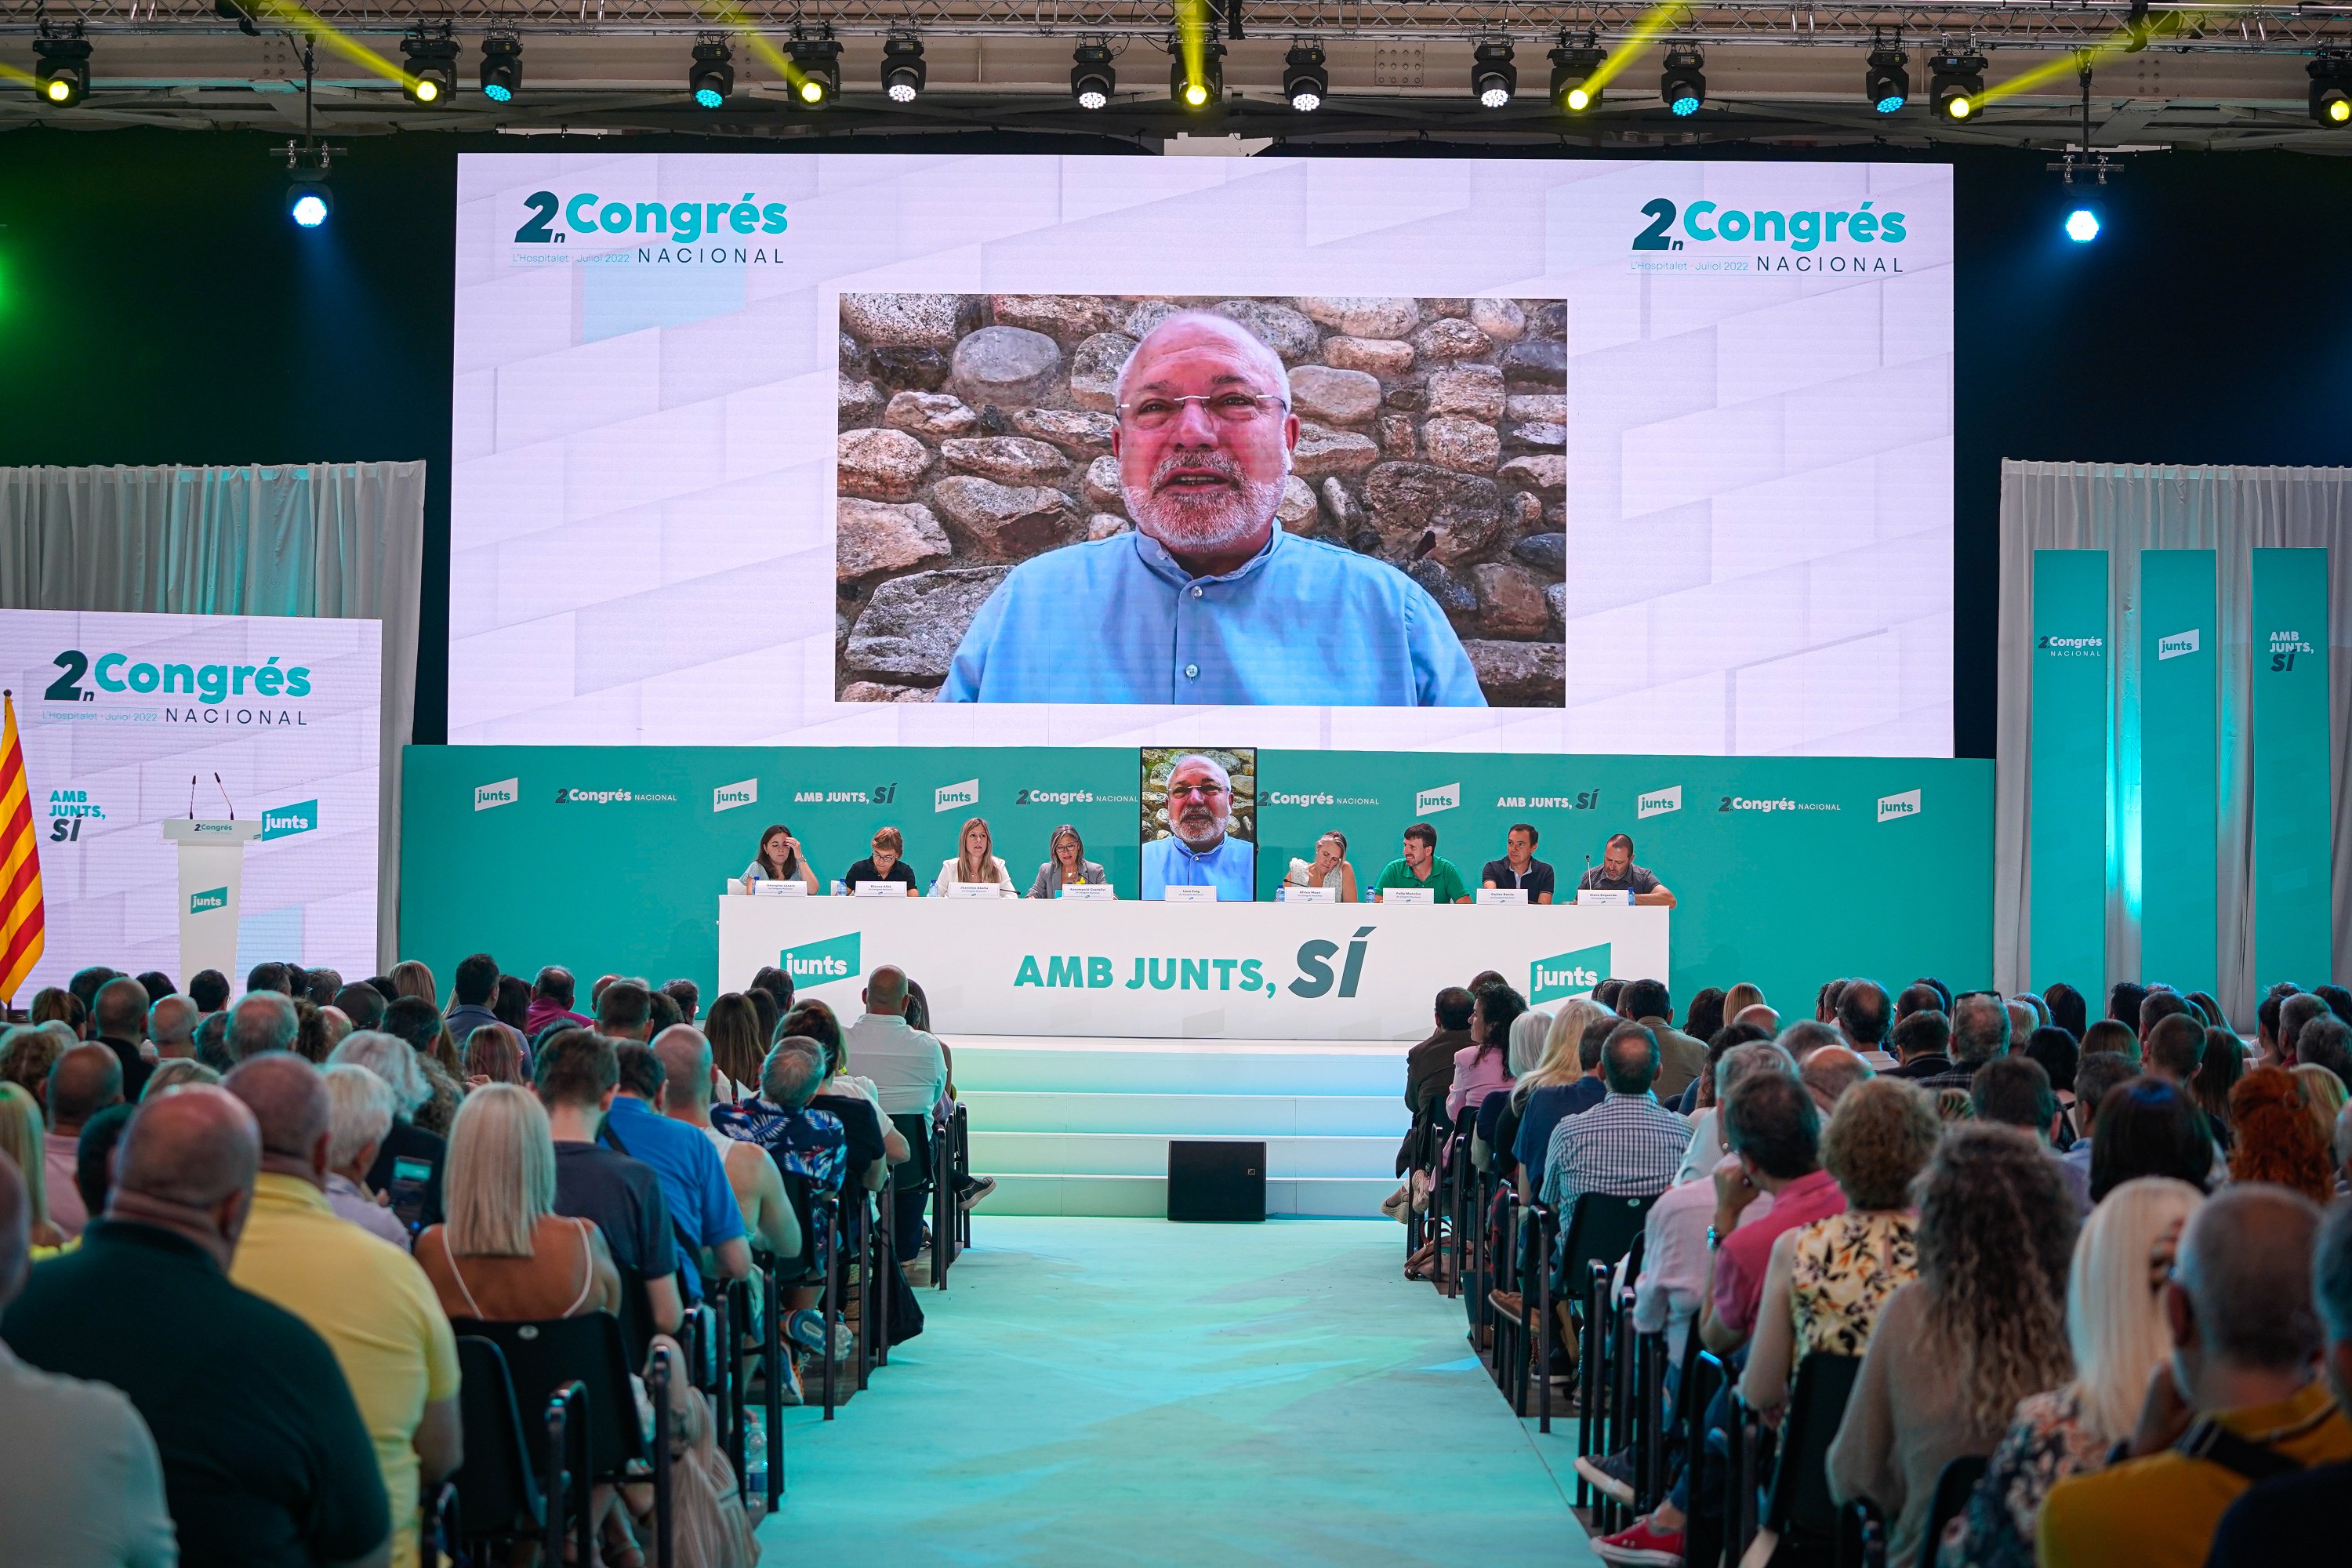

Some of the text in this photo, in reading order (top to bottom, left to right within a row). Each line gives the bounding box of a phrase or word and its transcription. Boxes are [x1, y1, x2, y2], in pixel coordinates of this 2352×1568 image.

[565, 191, 788, 243] Congrés
[1683, 200, 1907, 252] Congrés
[576, 252, 603, 263] Juliol
[604, 253, 630, 263] 2022
[637, 248, 785, 263] NACIONAL
[1694, 261, 1722, 271] Juliol
[1723, 261, 1749, 271] 2022
[1756, 256, 1904, 273] NACIONAL
[2049, 636, 2103, 649] Congrés
[2269, 631, 2299, 641] AMB
[2161, 640, 2193, 653] junts
[2269, 641, 2314, 655] JUNTS,
[2270, 649, 2297, 672] SÍ
[94, 652, 312, 705] Congrés
[133, 713, 158, 722] 2022
[165, 707, 307, 726] NACIONAL
[49, 789, 88, 803] AMB
[477, 789, 510, 804] junts
[568, 788, 632, 804] Congrés
[716, 790, 750, 804] junts
[794, 782, 898, 804] AMB JUNTS, SÍ
[938, 790, 971, 804] junts
[1030, 789, 1094, 805] Congrés
[1271, 791, 1334, 808] Congrés
[1420, 794, 1453, 808] junts
[1497, 788, 1601, 810] AMB JUNTS, SÍ
[1640, 797, 1674, 811] junts
[1733, 797, 1795, 813] Congrés
[1880, 800, 1914, 815] junts
[49, 804, 106, 821] JUNTS,
[49, 813, 85, 842] SÍ
[201, 824, 233, 833] Congrés
[265, 813, 309, 832] junts
[192, 895, 222, 909] junts
[786, 953, 848, 978] junts
[1014, 926, 1377, 1000] AMB JUNTS, SÍ
[1534, 964, 1599, 993] junts
